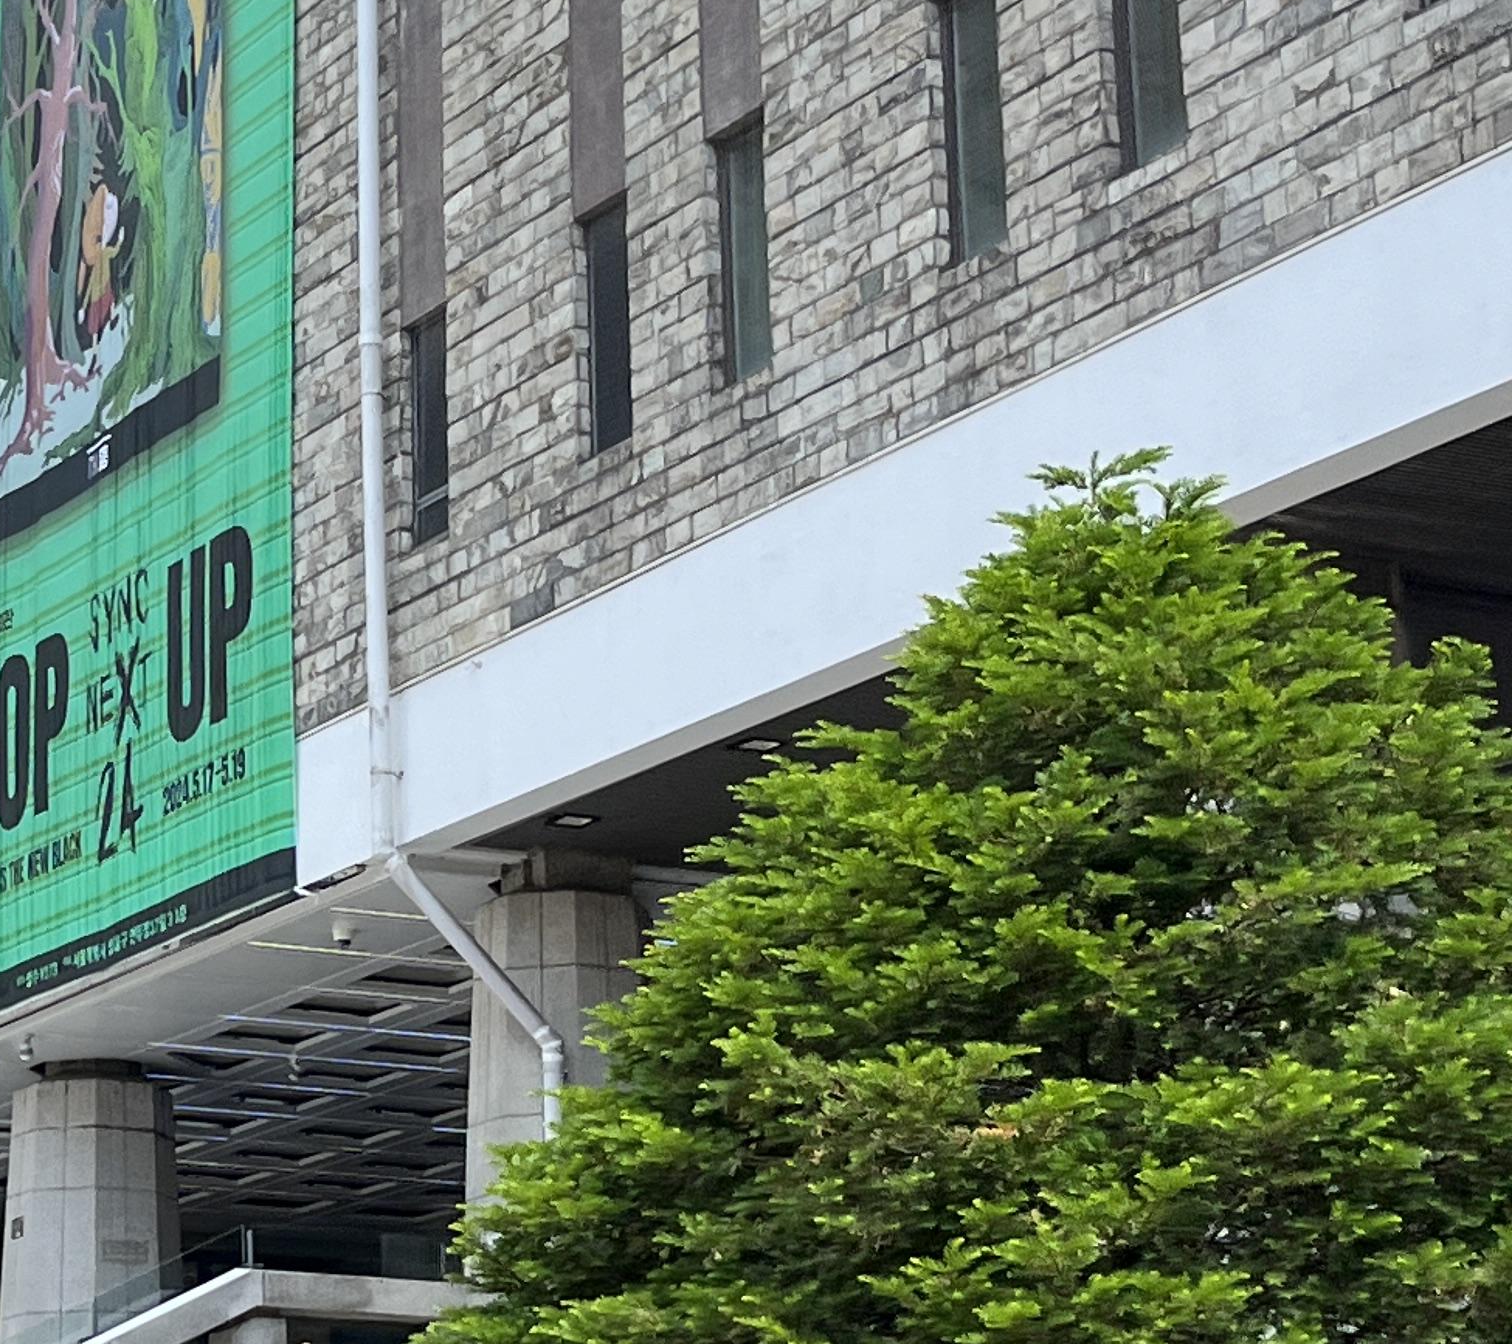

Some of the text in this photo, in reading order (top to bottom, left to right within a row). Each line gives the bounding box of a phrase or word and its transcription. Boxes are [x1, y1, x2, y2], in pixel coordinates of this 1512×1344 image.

[89, 568, 150, 653] SYNC
[166, 524, 253, 744] UP
[86, 637, 153, 746] NEXT
[95, 737, 145, 864] 24
